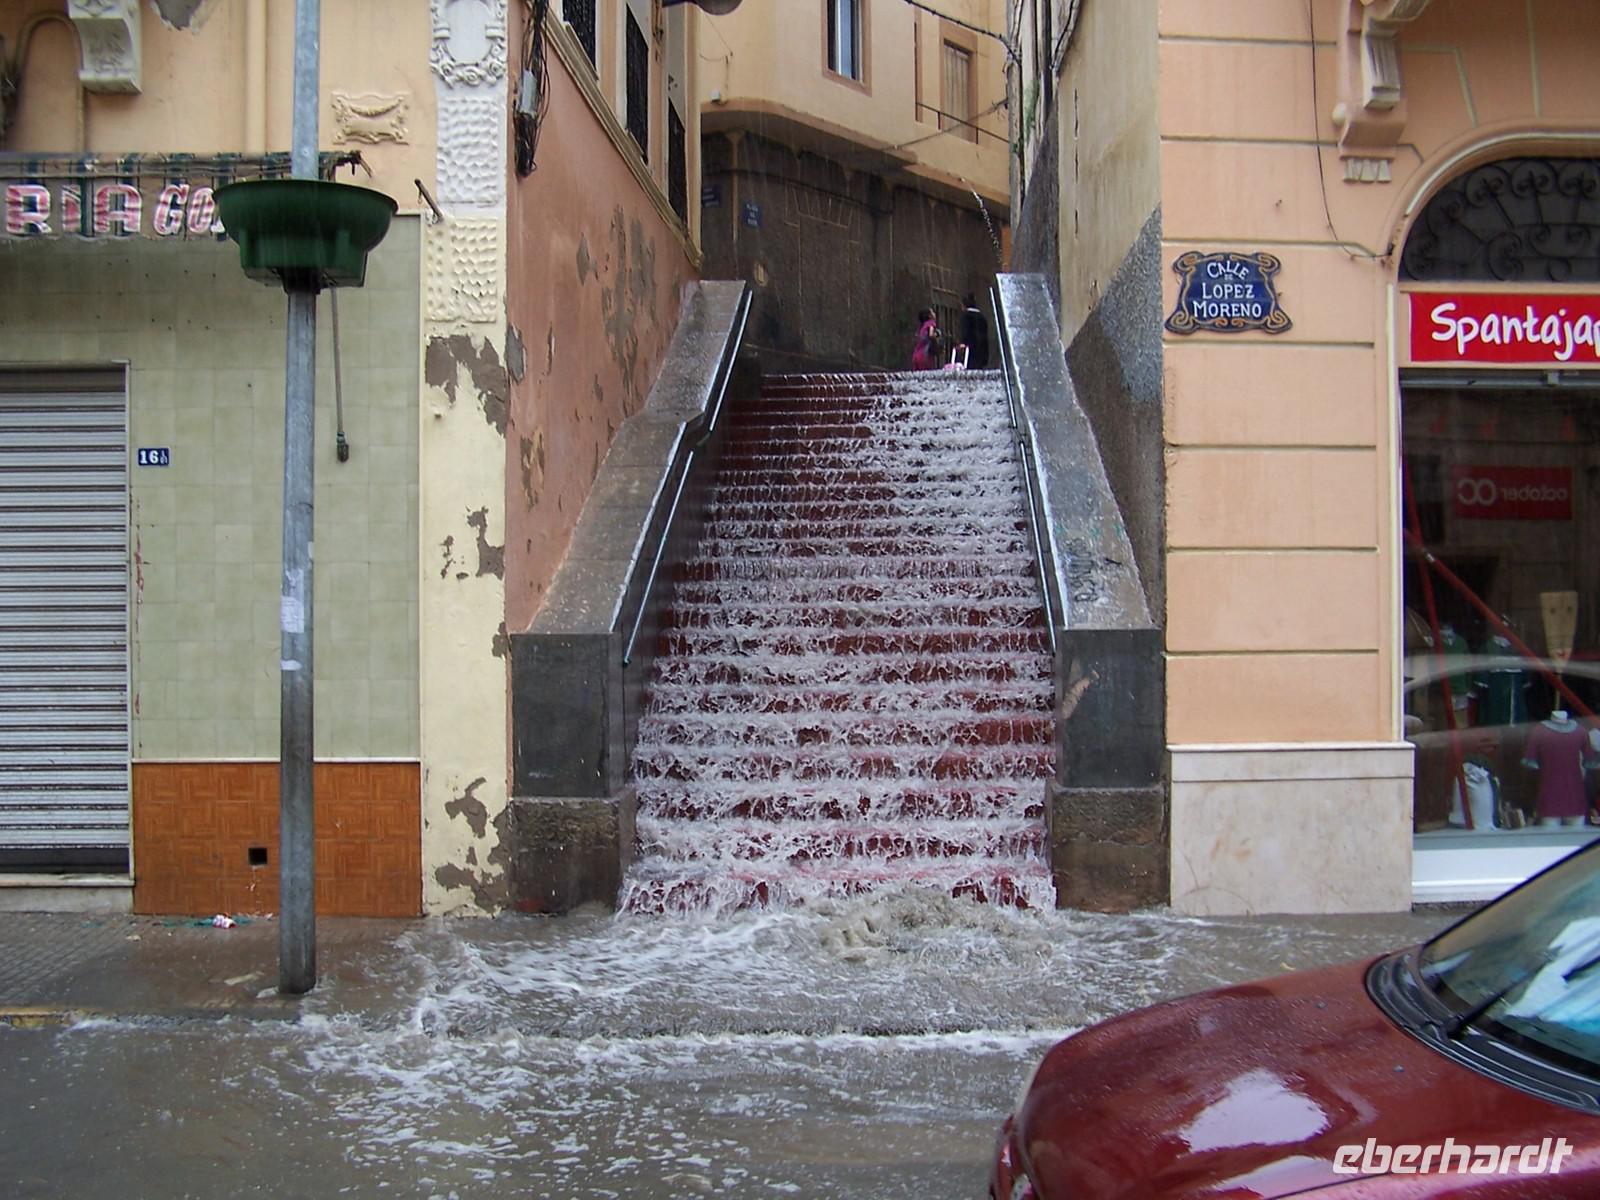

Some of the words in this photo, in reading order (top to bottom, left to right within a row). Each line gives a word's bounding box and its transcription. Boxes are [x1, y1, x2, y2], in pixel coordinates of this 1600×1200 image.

[153, 184, 226, 235] GO
[1206, 261, 1249, 280] CALLE
[1202, 282, 1255, 299] LOPEZ
[1193, 300, 1262, 318] MORENO
